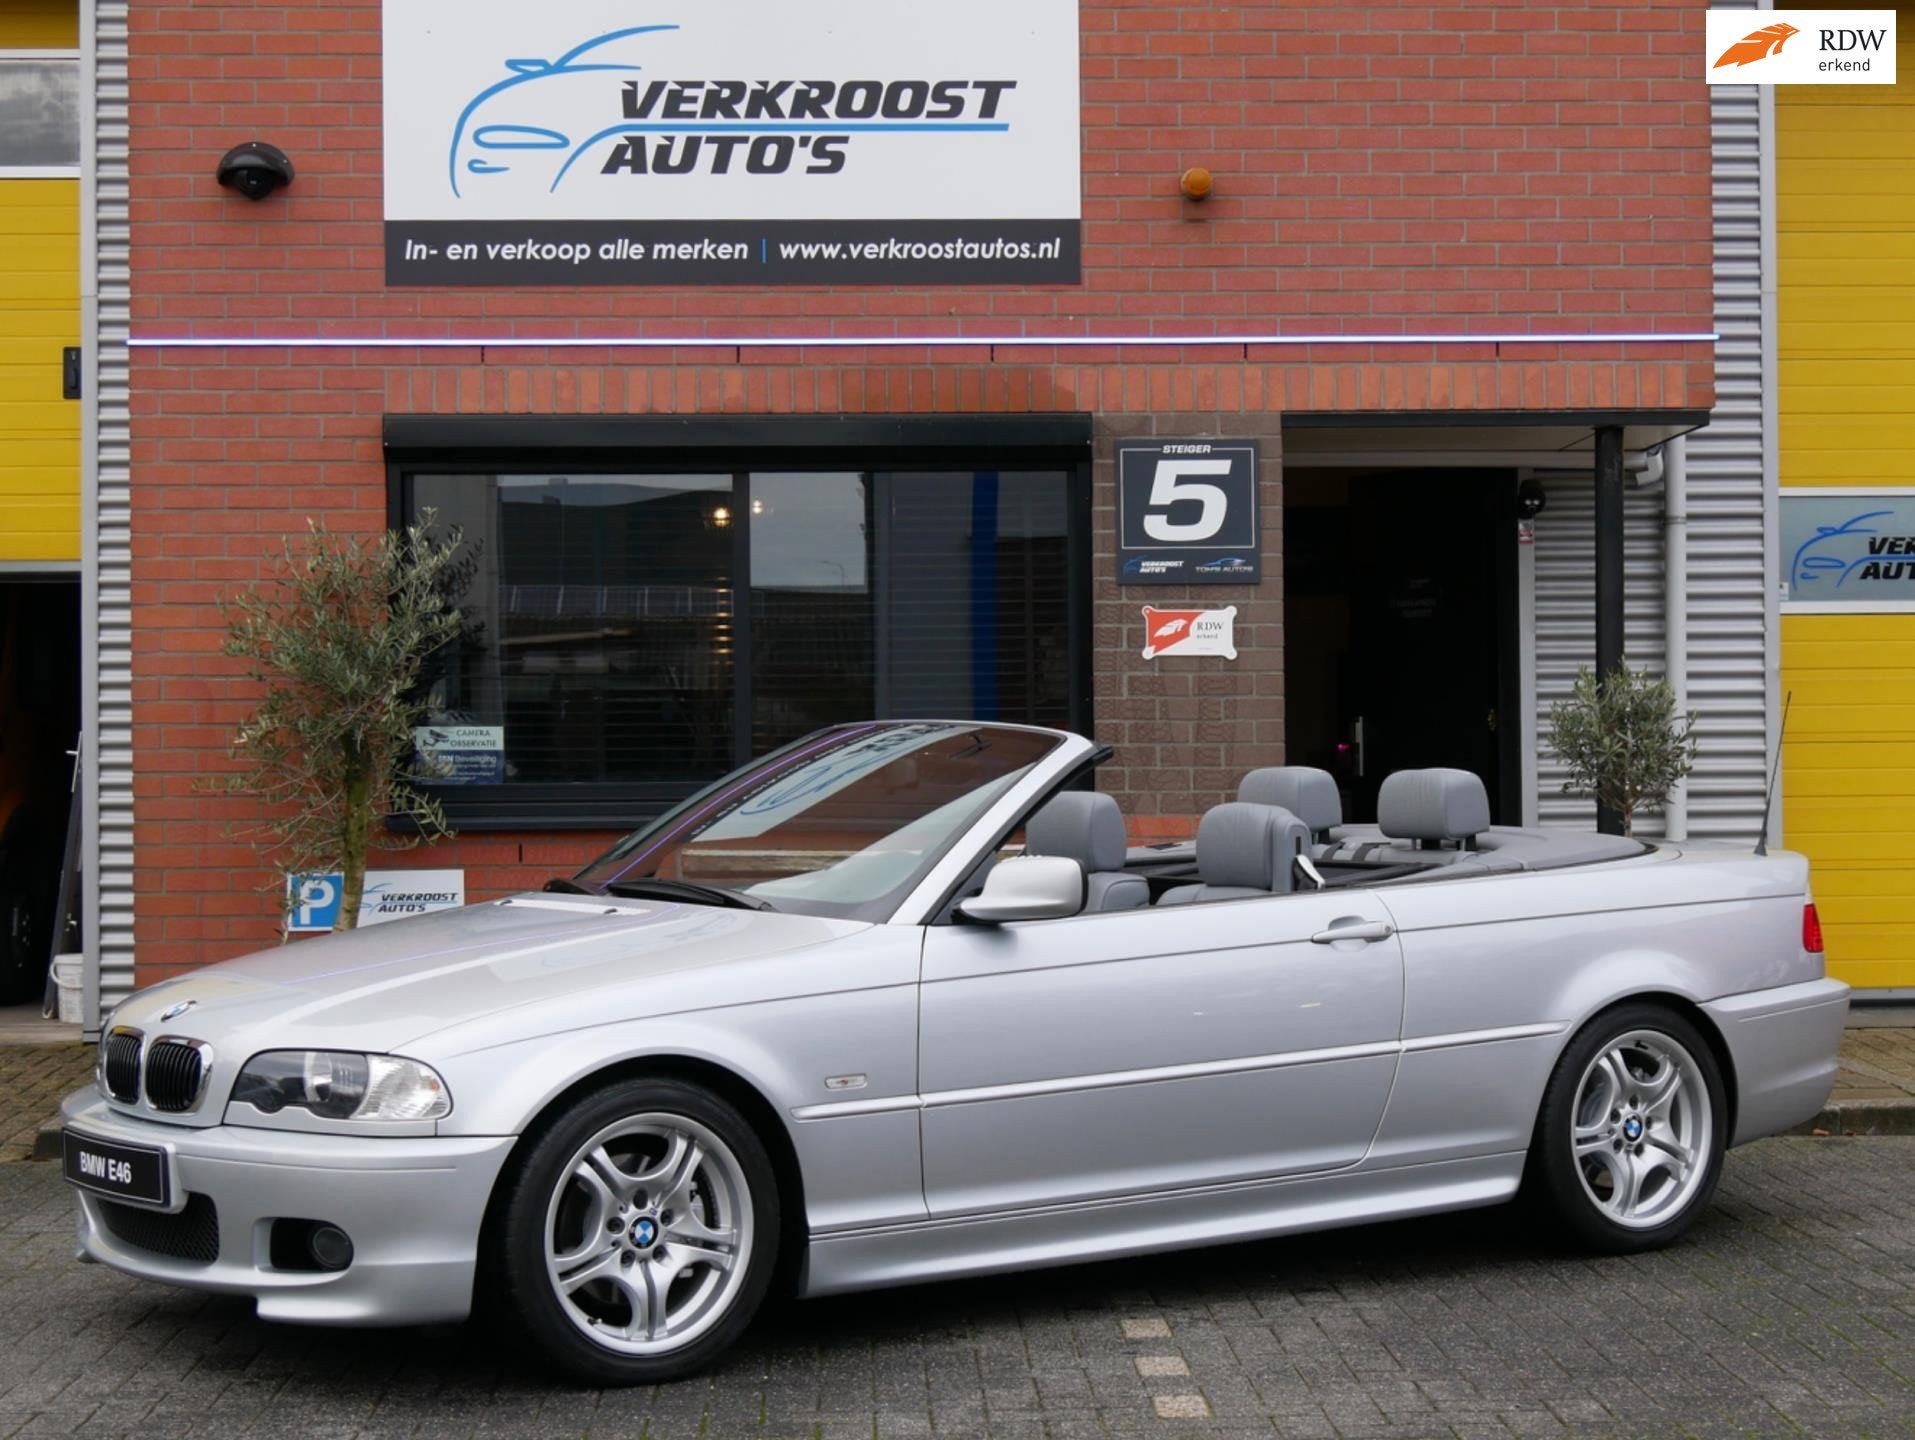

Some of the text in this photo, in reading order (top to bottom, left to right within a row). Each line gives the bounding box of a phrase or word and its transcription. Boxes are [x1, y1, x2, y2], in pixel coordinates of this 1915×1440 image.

[621, 80, 1017, 119] VERKROOST
[600, 136, 850, 174] AUTO'S
[405, 238, 1061, 264] In- en verkoop alle merken www.verkroostautos.nl
[1162, 444, 1212, 454] STEIGER
[1143, 459, 1232, 542] 5
[1197, 622, 1224, 630] RDW
[456, 729, 491, 737] CAMERA
[300, 880, 335, 925] P
[378, 904, 426, 913] AUTO'S
[381, 893, 458, 902] VERKROOST
[80, 1151, 132, 1184] BMW E46
